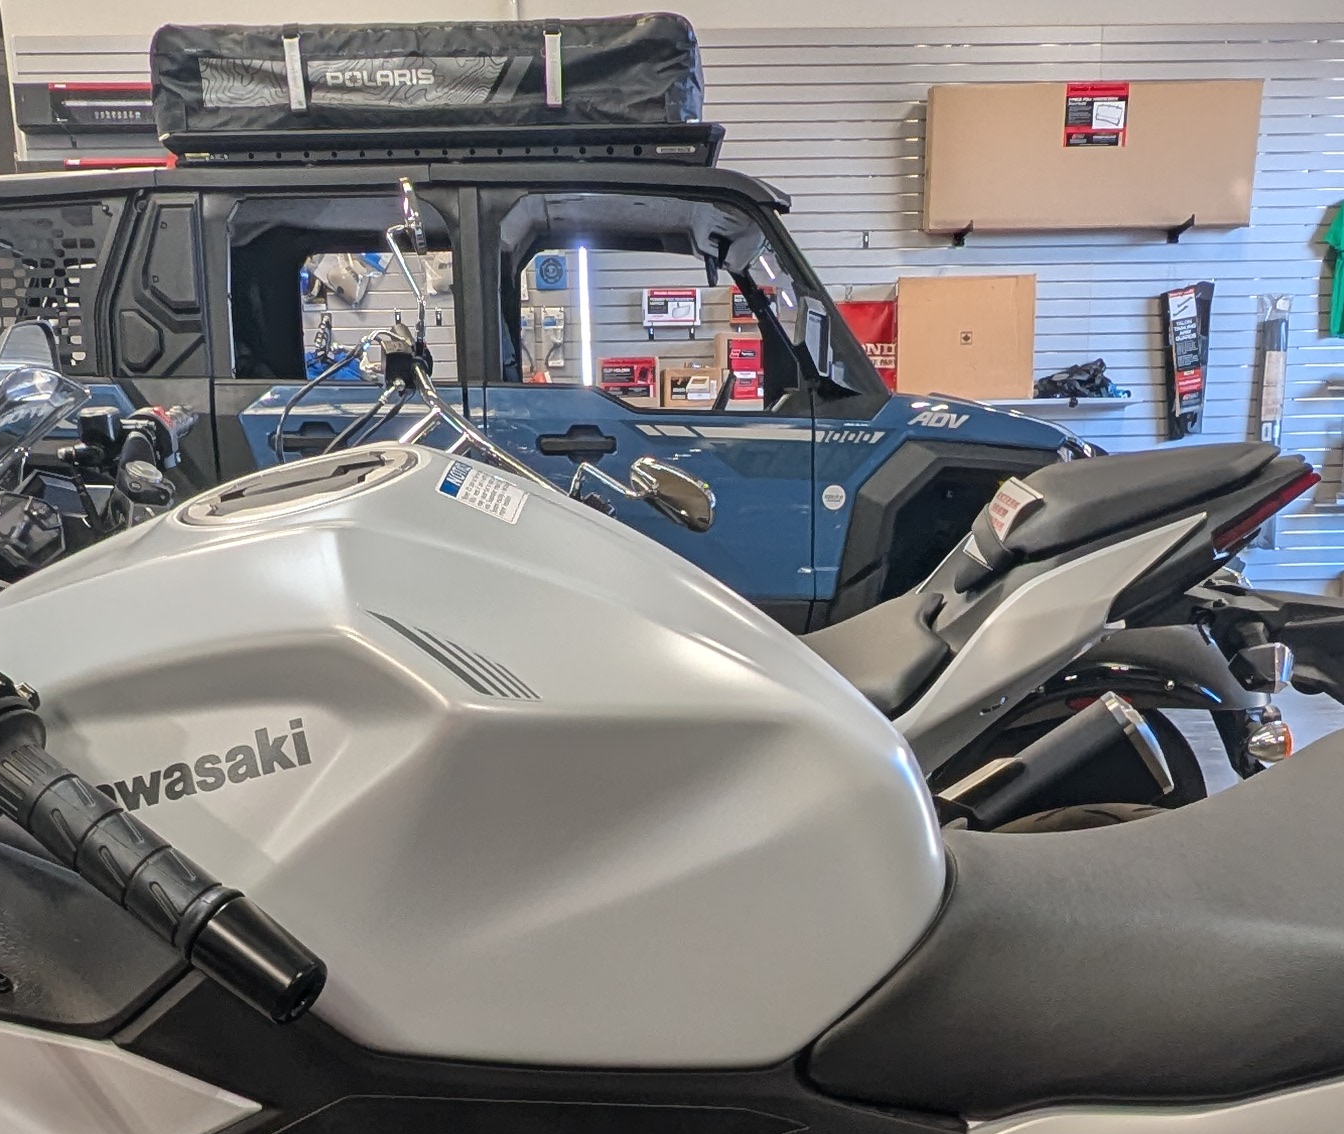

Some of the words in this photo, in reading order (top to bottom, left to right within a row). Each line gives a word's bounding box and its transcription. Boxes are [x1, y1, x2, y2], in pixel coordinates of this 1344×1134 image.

[326, 69, 435, 87] POLARIS
[907, 411, 970, 428] ADV
[96, 717, 312, 812] wasaki
